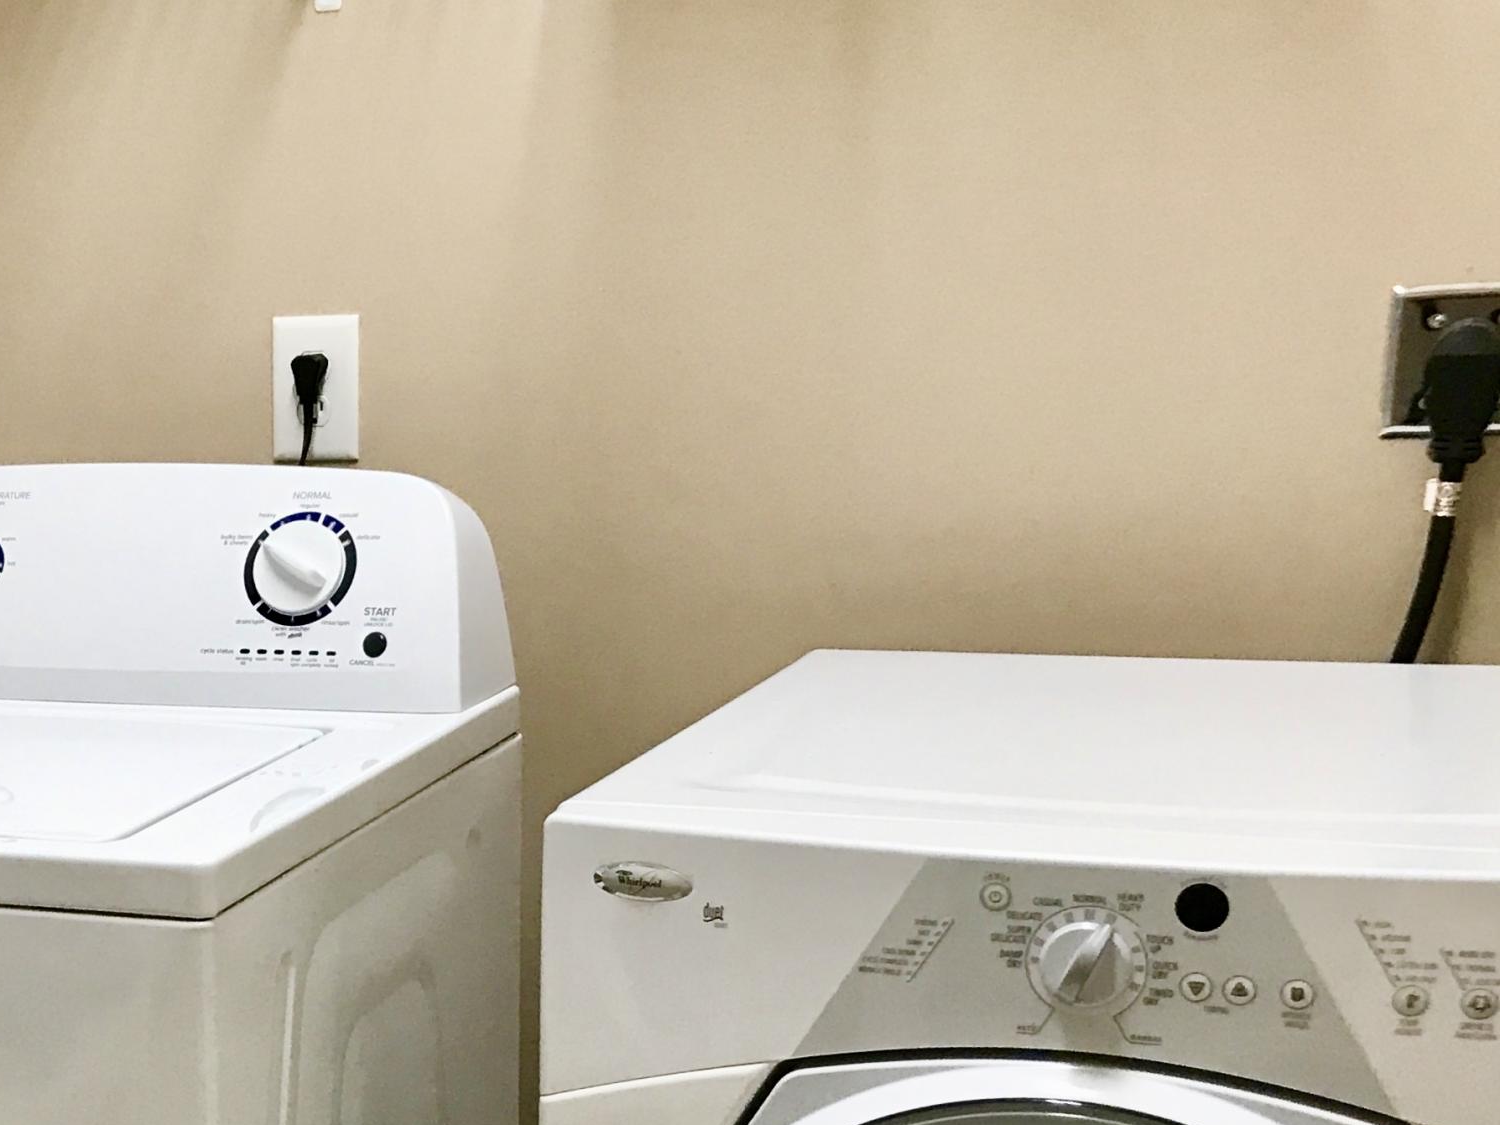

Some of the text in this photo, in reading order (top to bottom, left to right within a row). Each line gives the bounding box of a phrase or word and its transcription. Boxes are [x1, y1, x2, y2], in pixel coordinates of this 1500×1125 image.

[292, 491, 332, 500] NORMAL
[363, 606, 397, 618] START
[349, 659, 375, 667] CANCEL
[617, 874, 662, 890] Whirlpool
